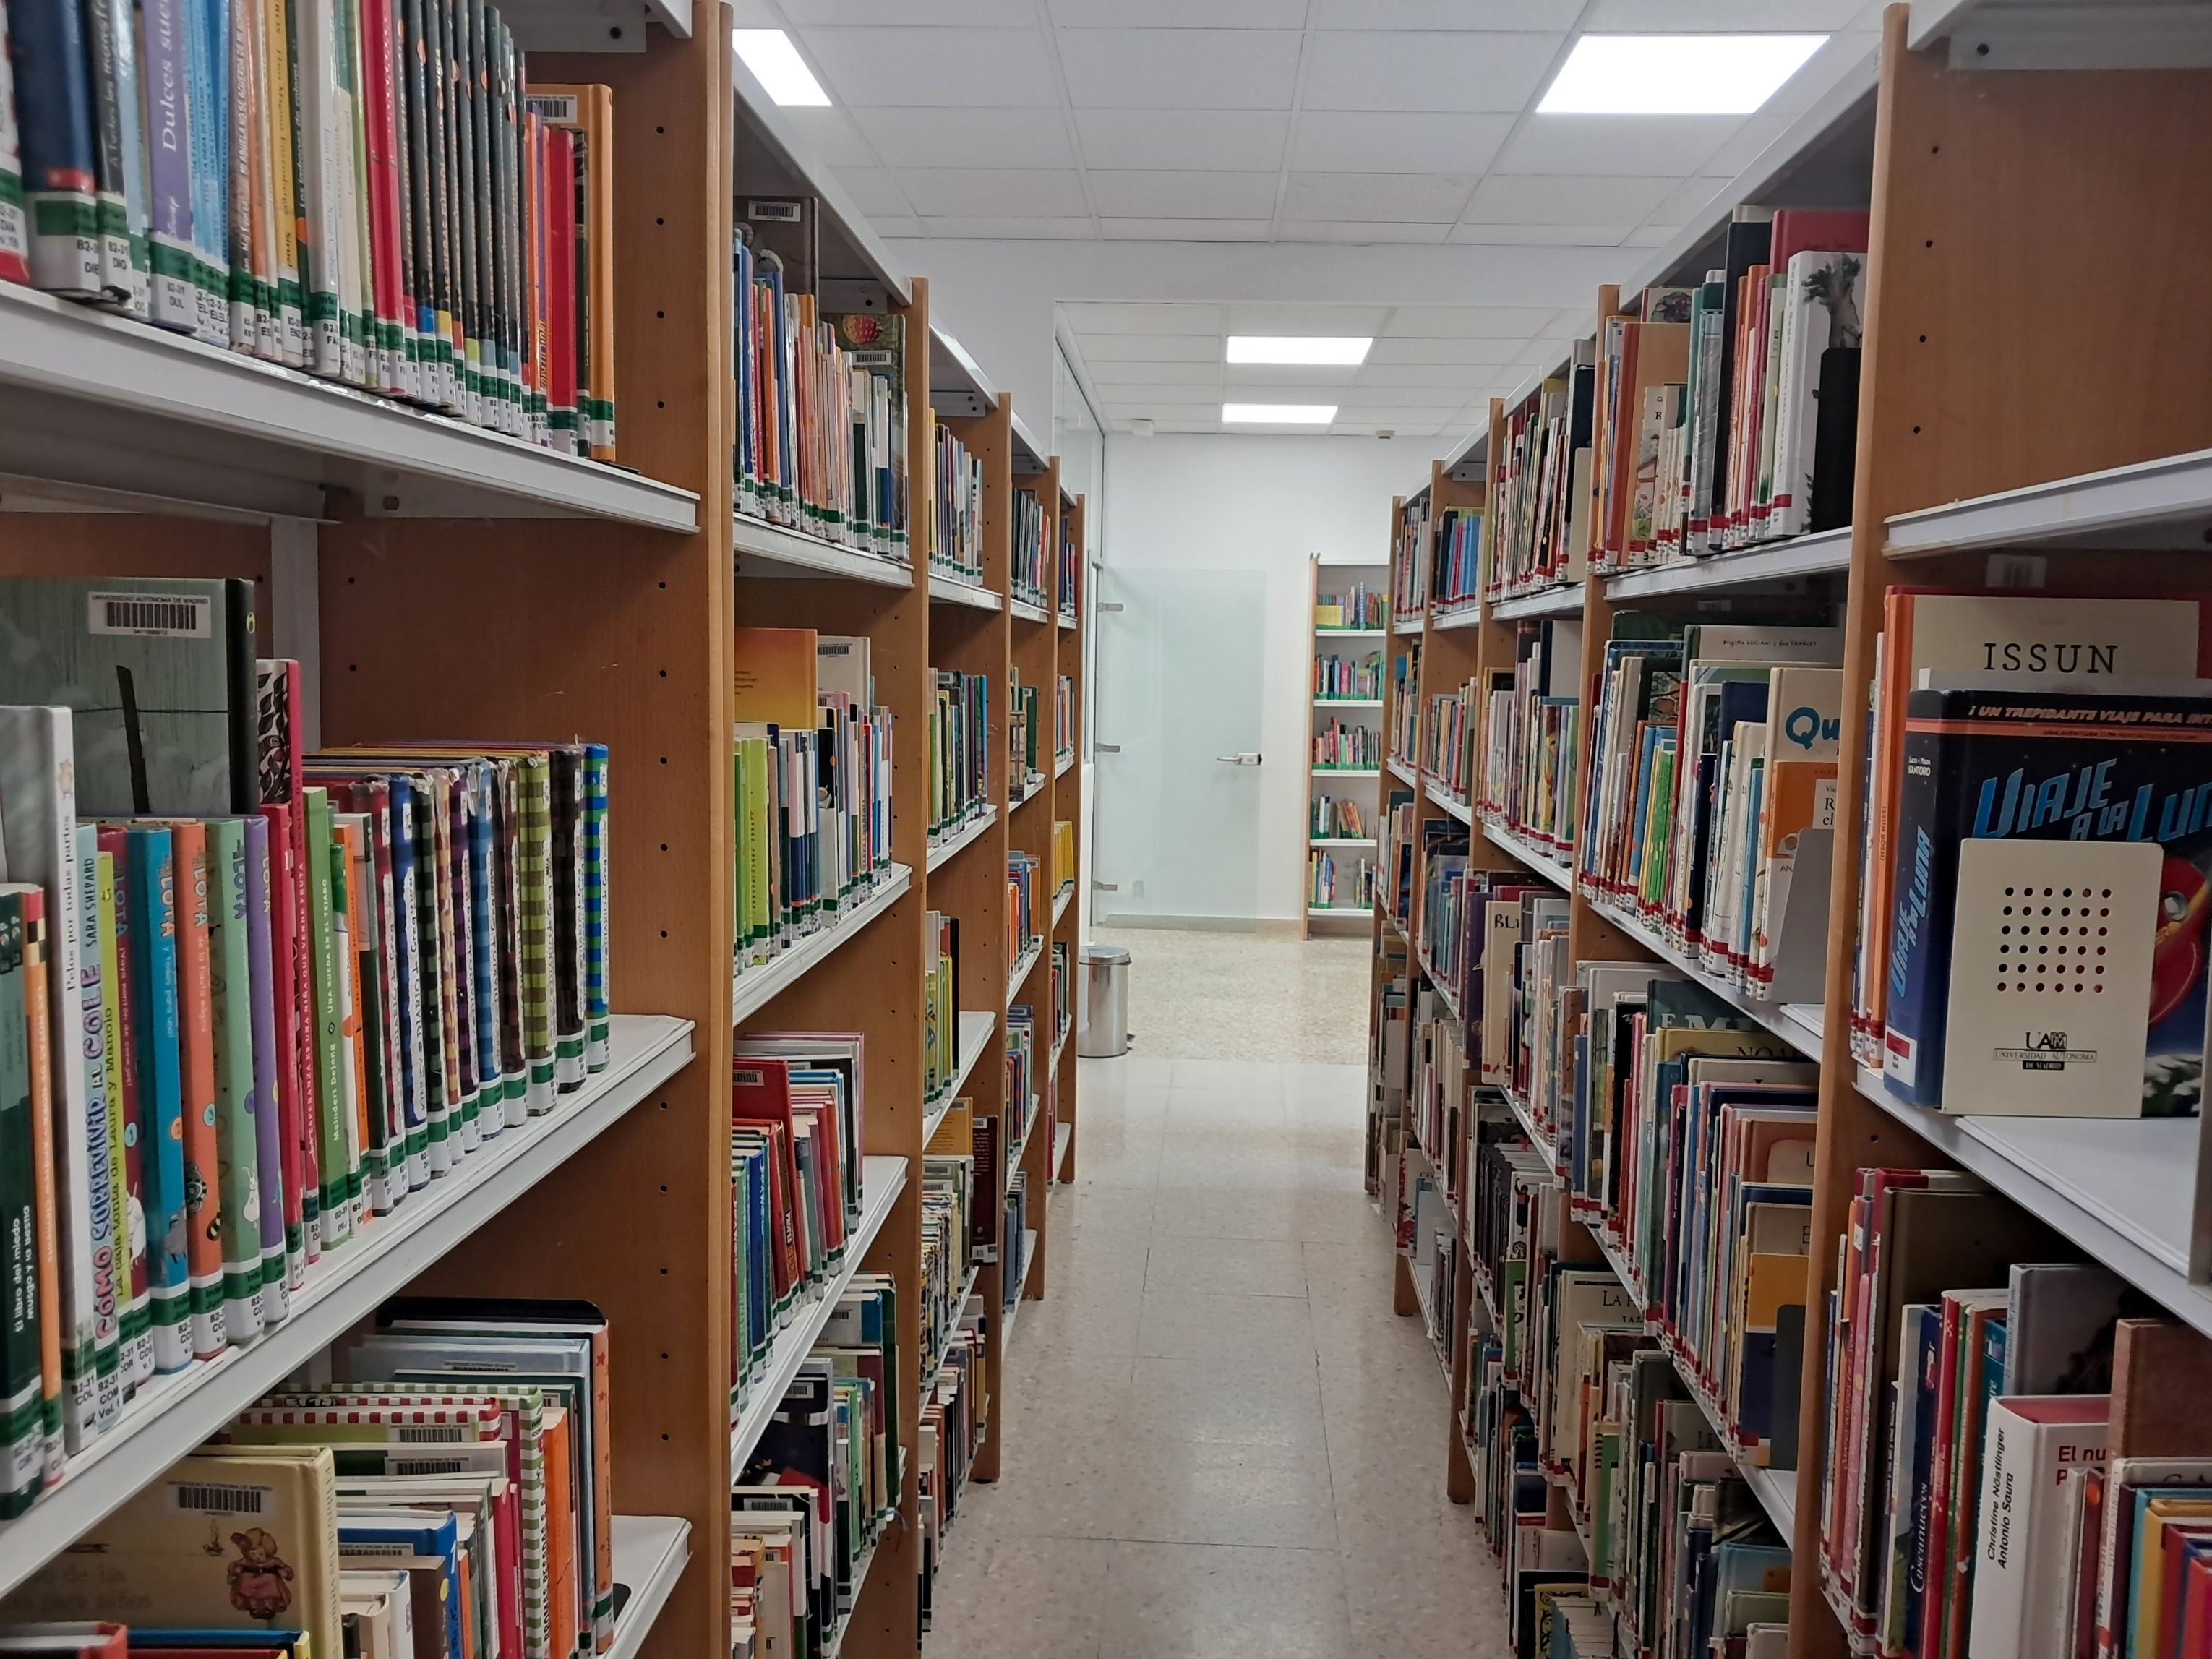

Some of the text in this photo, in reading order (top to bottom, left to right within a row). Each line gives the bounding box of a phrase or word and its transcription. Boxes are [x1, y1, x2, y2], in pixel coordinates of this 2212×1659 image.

[236, 59, 246, 99] ACUERDA
[160, 60, 177, 153] Dulces
[238, 127, 247, 163] ABUELA
[1984, 643, 2118, 674] ISSUN
[2005, 707, 2098, 721] TREPIDANTE
[2099, 711, 2140, 723] VIAJE
[2142, 712, 2183, 724] PARA
[1908, 765, 1931, 776] SANTORO
[1973, 758, 2117, 839] VIAJE
[2070, 800, 2129, 840] A LA
[233, 858, 247, 920] LOTA
[1909, 825, 1931, 917] LUNA
[63, 815, 77, 991] Pelos por todas partes
[84, 858, 97, 948] SARA SHEPARD
[113, 876, 129, 938] LOTA
[160, 875, 176, 938] LOTA
[193, 867, 208, 927] LOTA
[321, 879, 330, 917] TEJADO
[299, 908, 308, 948] VENDE
[324, 920, 331, 932] EL
[325, 936, 332, 949] EN
[409, 916, 419, 953] Greg
[300, 953, 309, 977] QUE
[1891, 901, 1911, 998] VIAJE
[301, 982, 311, 1013] NIÑA
[390, 987, 400, 1047] DIARIO
[413, 978, 423, 1037] DIARIO
[103, 1008, 114, 1072] Manolo
[302, 1016, 312, 1042] UNA
[303, 1046, 312, 1059] ES
[1995, 1051, 2095, 1061] UNIVERSIDAD AUTONOMA
[304, 1064, 314, 1135] ESPERANZA
[330, 1089, 340, 1141] Meindert
[106, 1099, 117, 1150] Laura
[80, 964, 117, 1340] CÓMO SOBREVIVIR AL COLE
[108, 1157, 119, 1178] de
[109, 1183, 120, 1229] tonta
[112, 1236, 124, 1270] caja
[11, 1218, 24, 1333] El libro del miedo
[120, 1347, 134, 1362] 2-31
[71, 1374, 95, 1394] 82-31
[74, 1388, 95, 1406] COL
[98, 1373, 119, 1392] 82-31
[99, 1385, 119, 1405] COM
[2058, 1446, 2106, 1462] El nu
[1987, 1427, 2005, 1561] Christine Nöstlinger
[1909, 1482, 1929, 1594] Cascanueces
[1998, 1472, 2013, 1570] Antonio Saura
